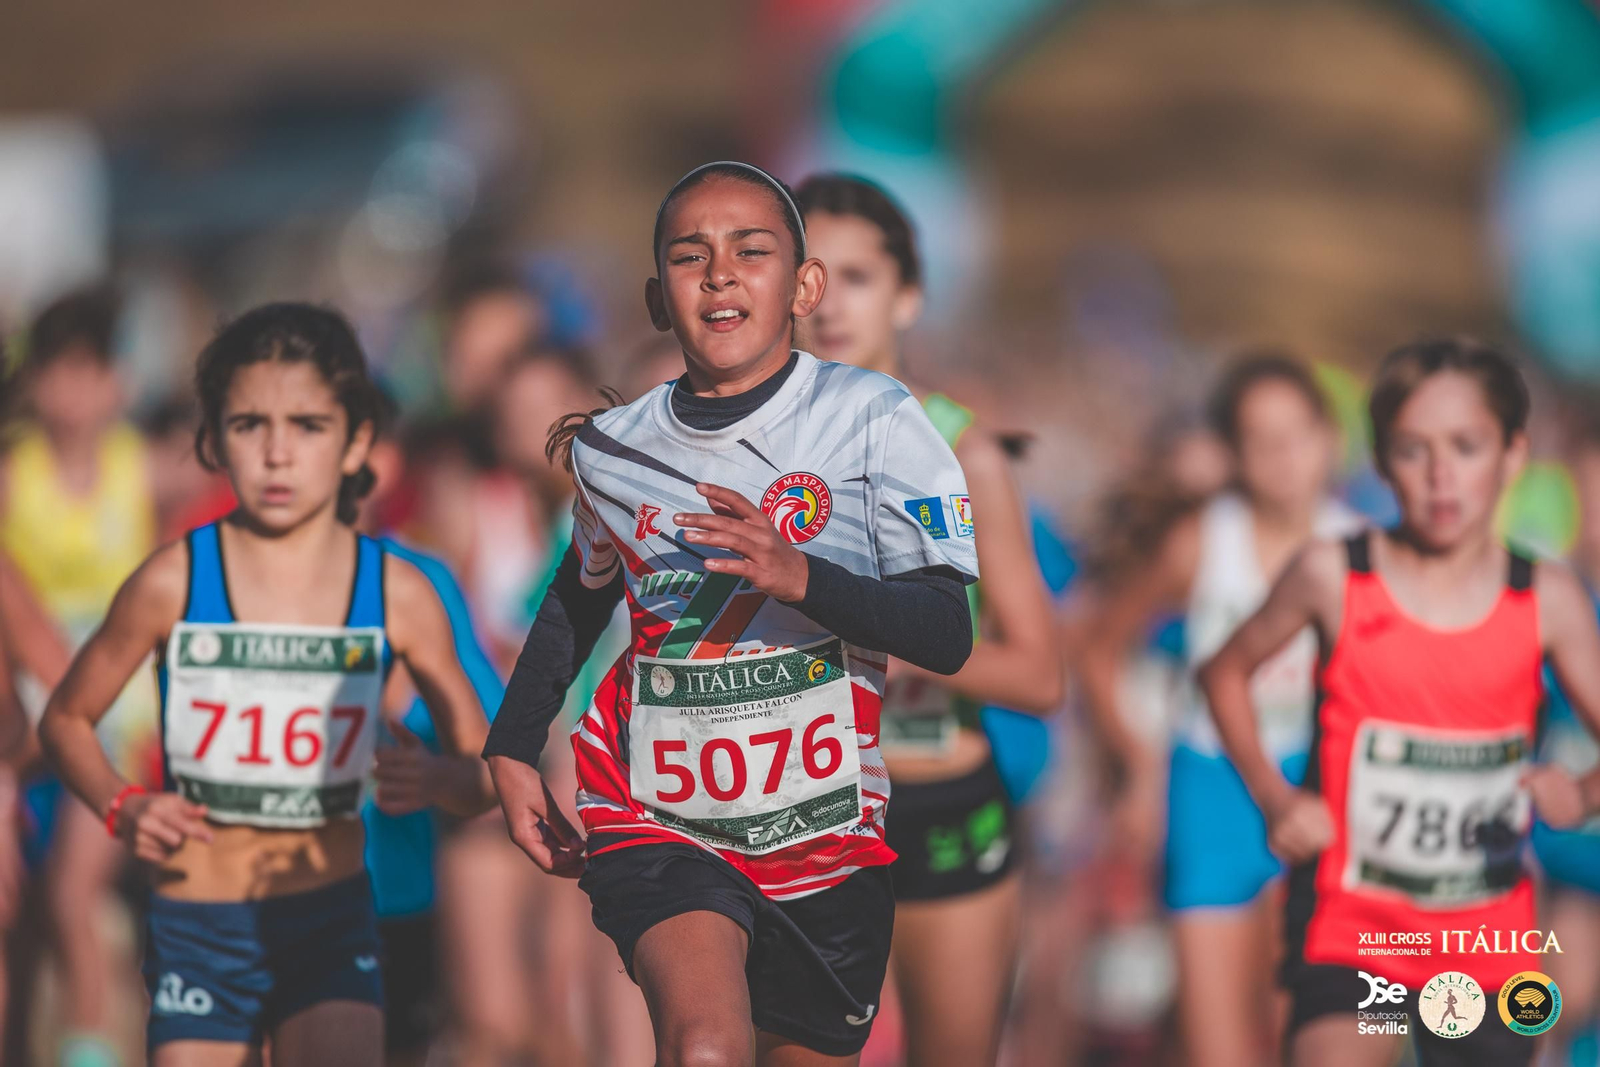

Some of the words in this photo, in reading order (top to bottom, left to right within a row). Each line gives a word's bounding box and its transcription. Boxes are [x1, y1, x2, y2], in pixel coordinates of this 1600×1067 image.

[763, 486, 780, 508] SBT
[783, 475, 829, 532] MASPALOMAS
[686, 662, 794, 694] ITÁLICA
[686, 689, 739, 700] INTERNATIONAL
[741, 687, 761, 695] CROSS
[764, 681, 794, 691] COUNTRY
[679, 708, 706, 716] JULIA
[708, 702, 763, 715] ARISQUETA
[765, 693, 803, 708] FALCON
[711, 710, 773, 724] INDEPENDIENTE
[191, 699, 367, 768] 7167
[653, 713, 843, 804] 5076
[818, 799, 850, 814] docunova
[781, 828, 816, 844] ATLETISMO
